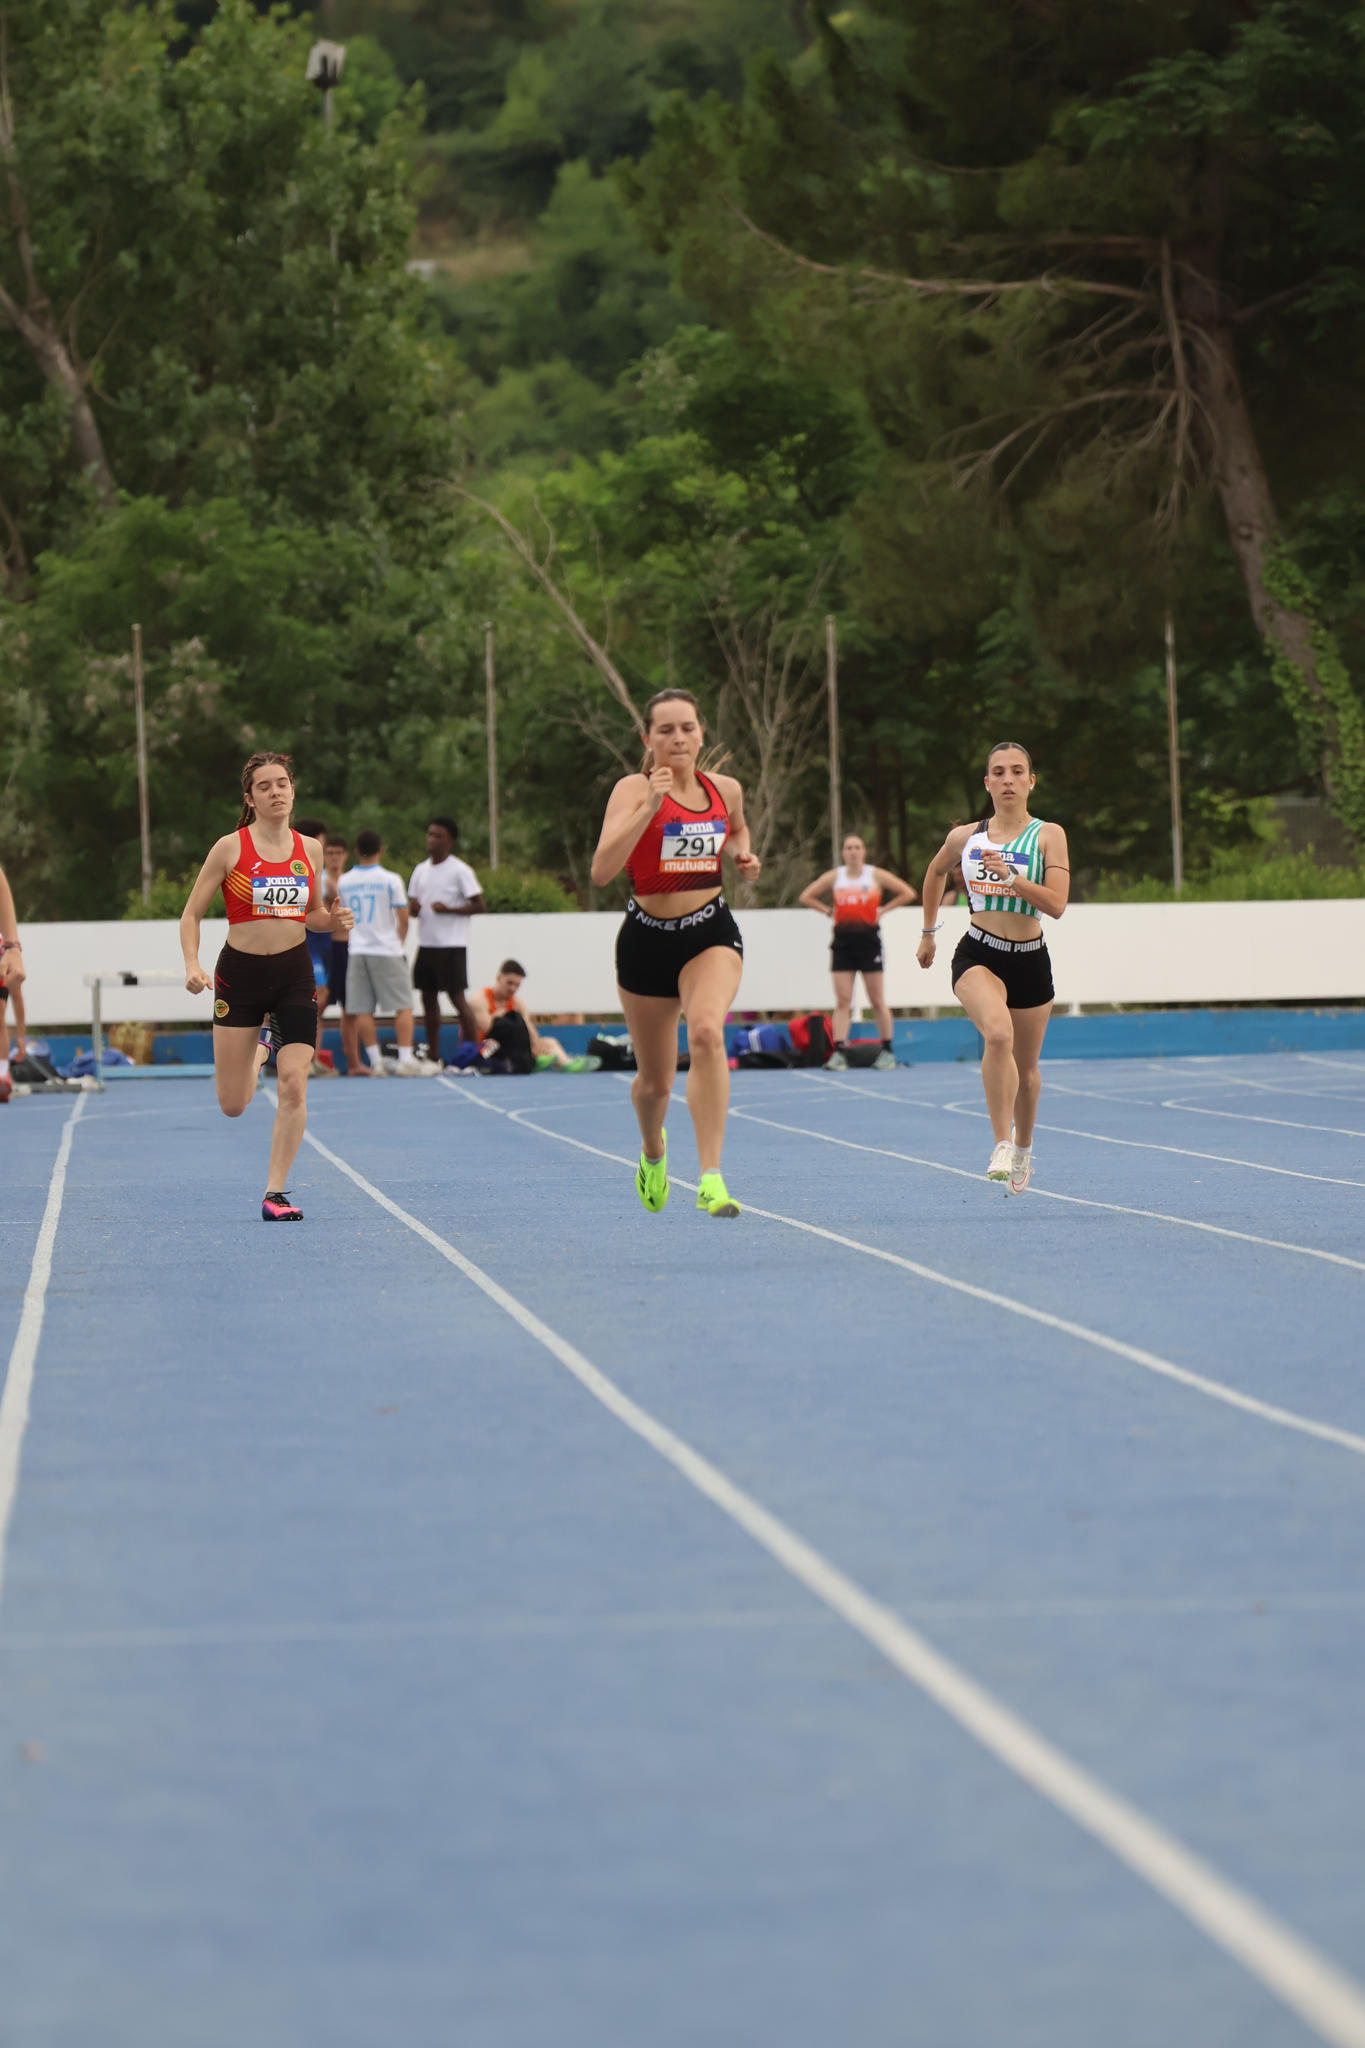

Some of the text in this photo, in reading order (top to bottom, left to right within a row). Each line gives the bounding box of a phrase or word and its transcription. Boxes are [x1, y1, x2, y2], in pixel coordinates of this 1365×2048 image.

[674, 837, 717, 857] 291
[263, 887, 299, 905] 402
[349, 895, 377, 924] 97
[635, 911, 678, 931] NIKE
[680, 903, 716, 930] PRO
[982, 934, 1012, 953] PUMA
